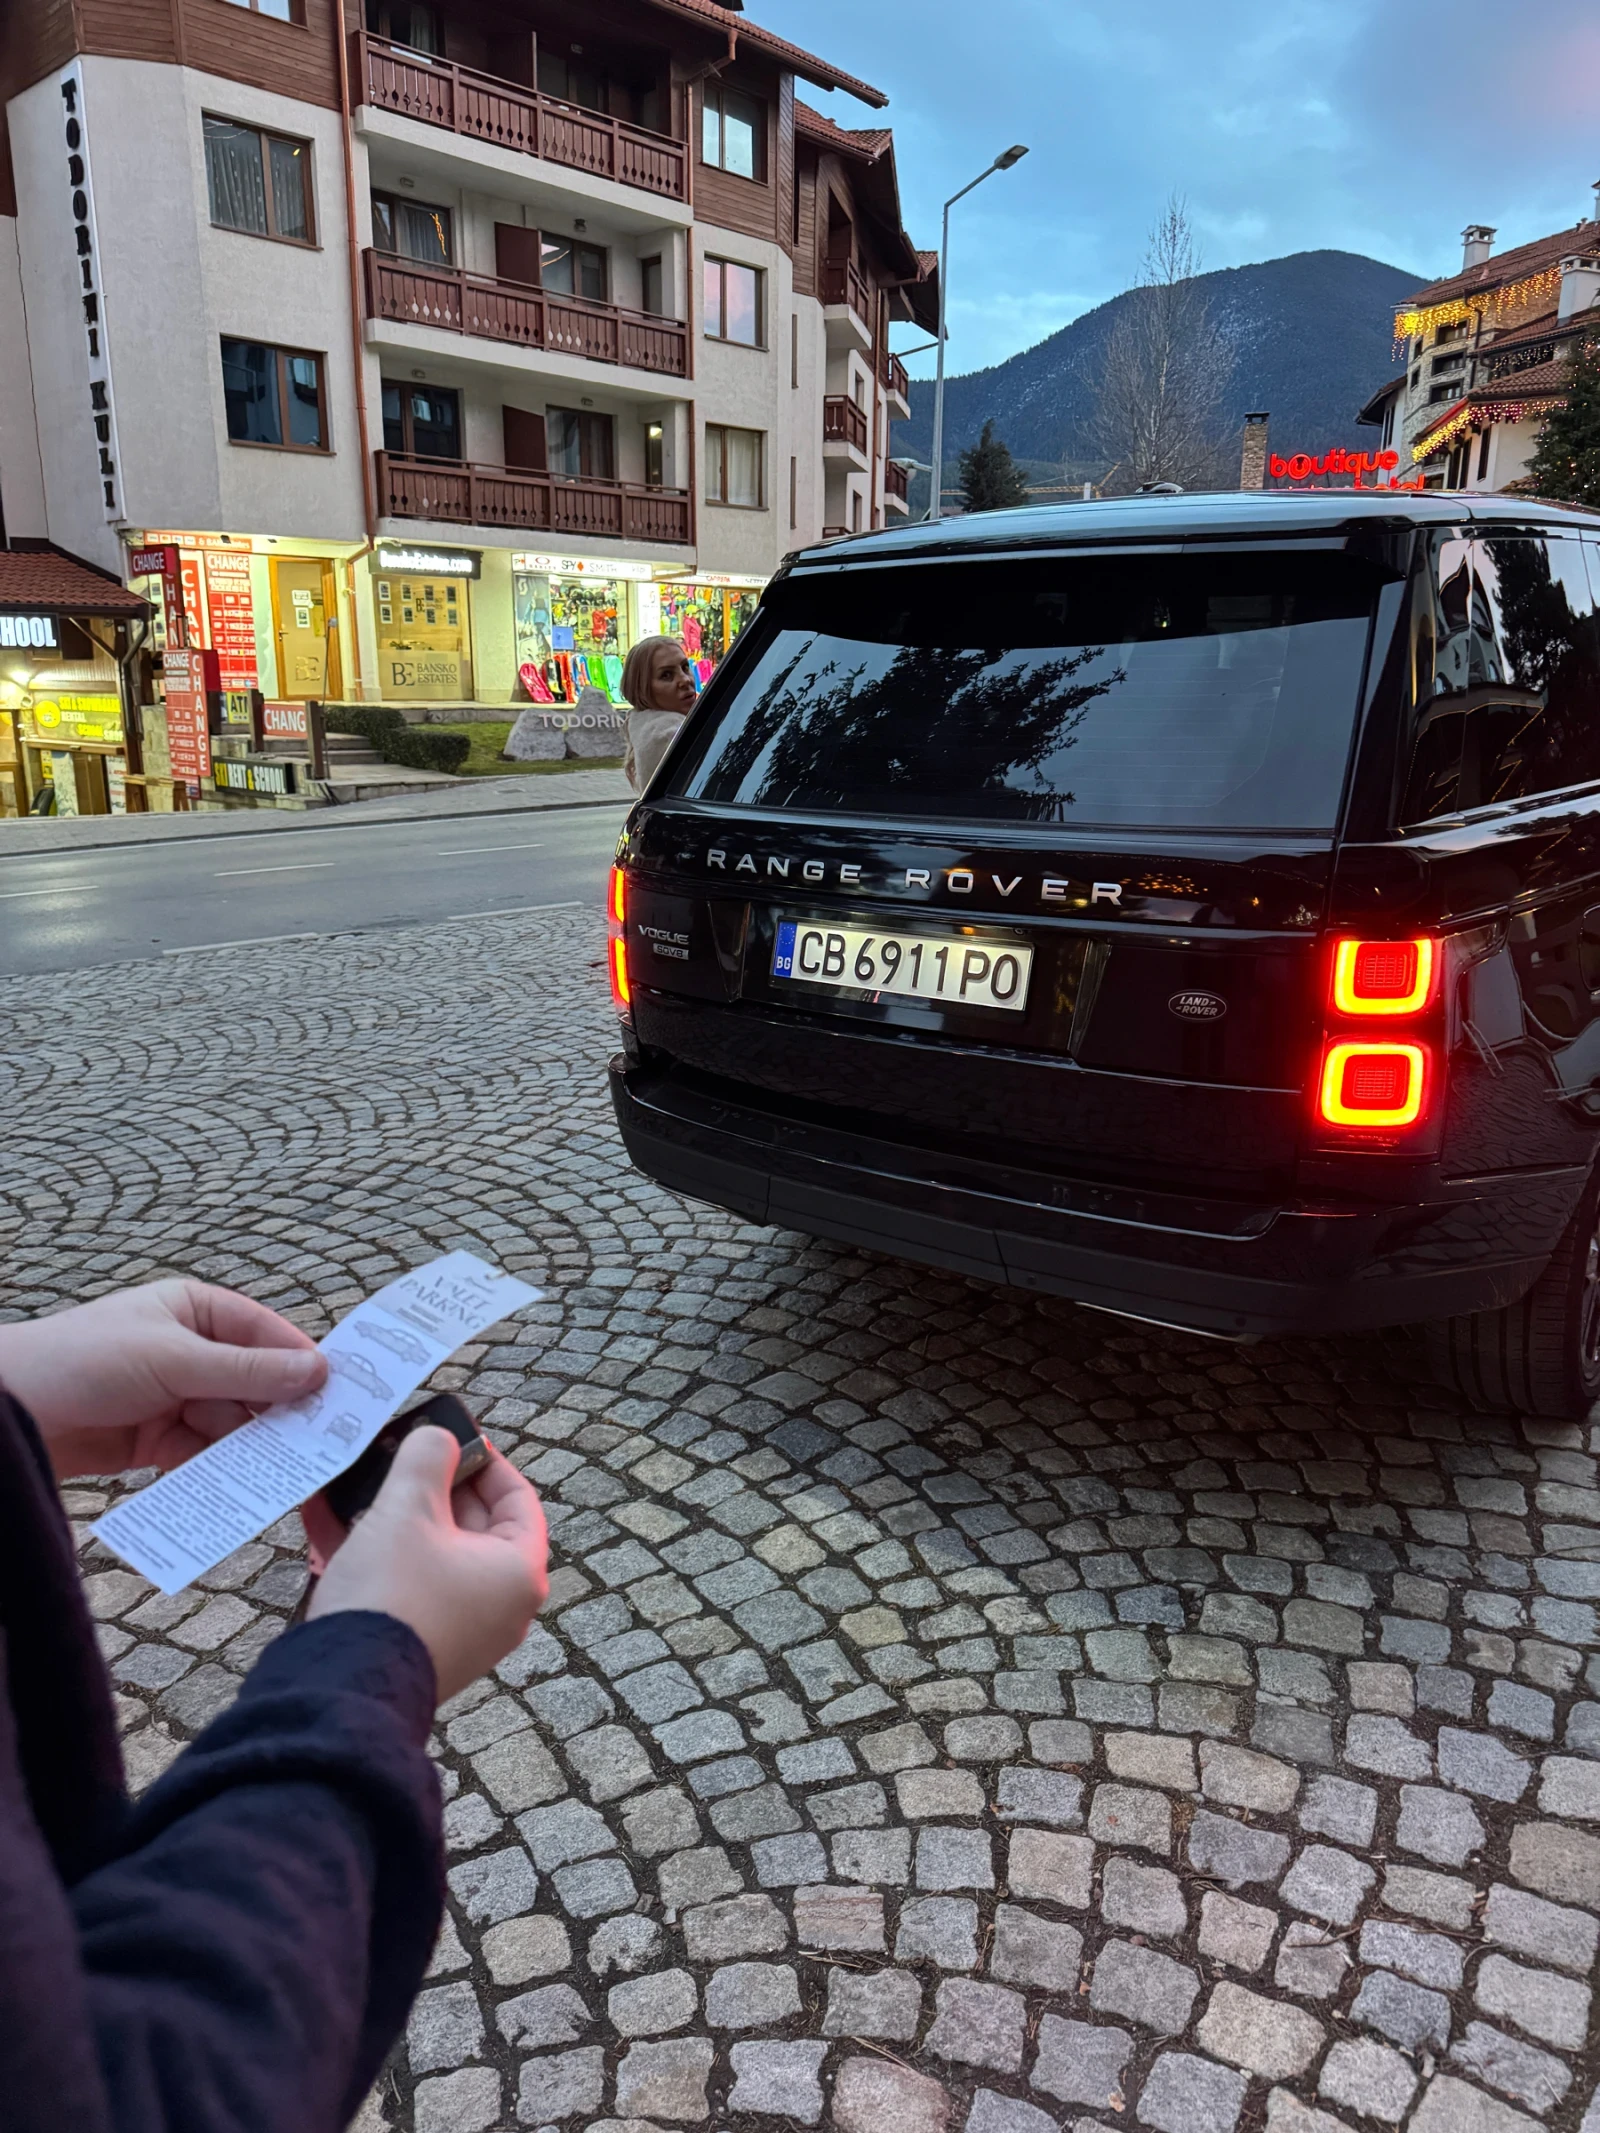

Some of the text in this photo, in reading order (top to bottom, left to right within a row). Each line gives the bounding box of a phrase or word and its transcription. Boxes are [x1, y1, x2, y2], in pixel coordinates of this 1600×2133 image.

[90, 380, 115, 509] KULI
[1270, 447, 1400, 480] boutique
[132, 552, 165, 572] CHANGE
[207, 554, 250, 571] CHANGE
[561, 559, 577, 571] SPY
[0, 616, 57, 647] HOOL
[163, 653, 190, 668] CHANGE
[416, 663, 457, 673] BANSKO
[391, 662, 415, 687] BE
[417, 673, 458, 684] ESTATES
[191, 655, 207, 771] CHANGE
[264, 708, 306, 733] CHANG
[214, 762, 228, 787] SKI
[228, 763, 247, 789] RENT
[247, 769, 254, 790] &
[253, 765, 286, 794] SCHOOL
[706, 849, 1123, 907] RANGE ROVER
[638, 924, 690, 945] VOGUE
[775, 955, 792, 971] BG
[1179, 996, 1210, 1007] LAND
[1181, 1005, 1218, 1016] ROVER
[399, 1277, 486, 1330] PARKING
[433, 1274, 493, 1310] VALET
